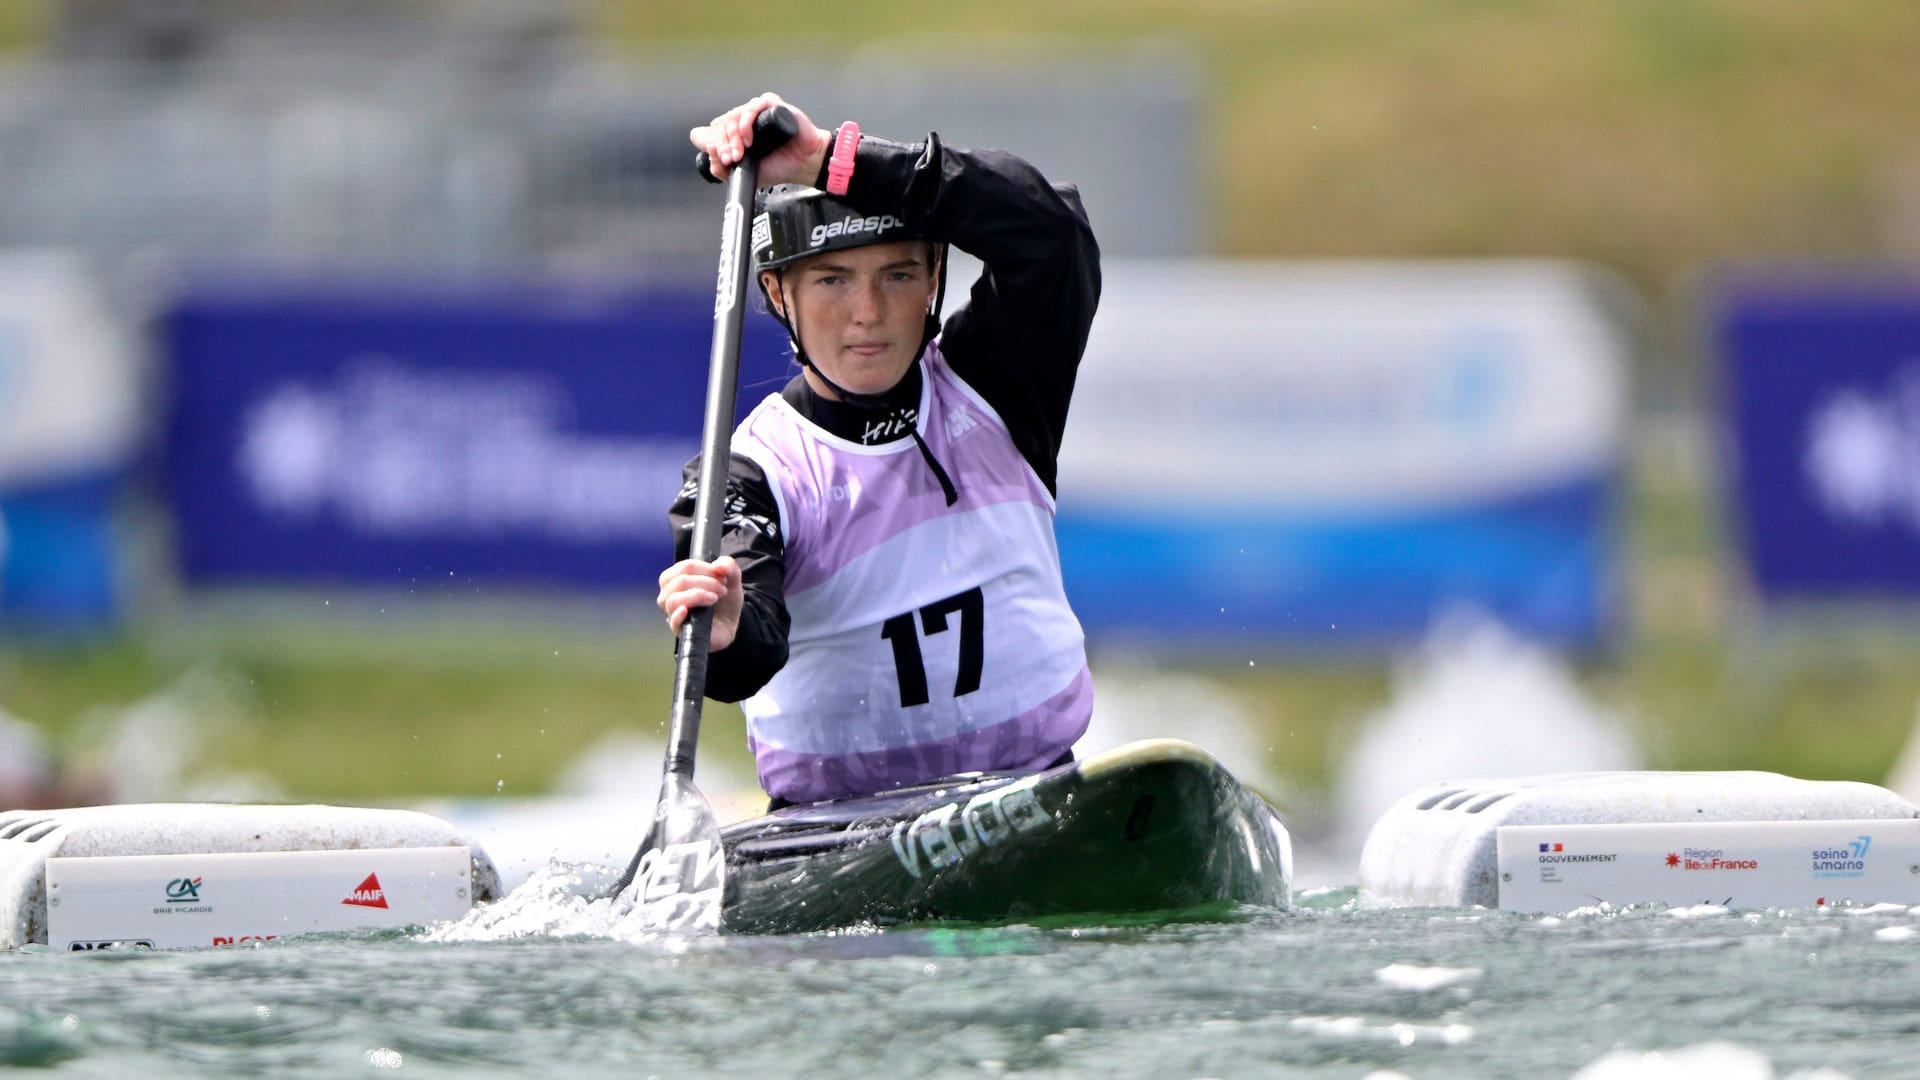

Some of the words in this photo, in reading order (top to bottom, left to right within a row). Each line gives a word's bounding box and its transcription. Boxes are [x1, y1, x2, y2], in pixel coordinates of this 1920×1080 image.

[881, 586, 984, 708] 17
[1539, 854, 1617, 863] GOUVERNEMENT
[1684, 848, 1723, 860] Région
[1813, 848, 1848, 859] seine
[1813, 861, 1864, 870] &marne
[350, 889, 383, 901] MAIF
